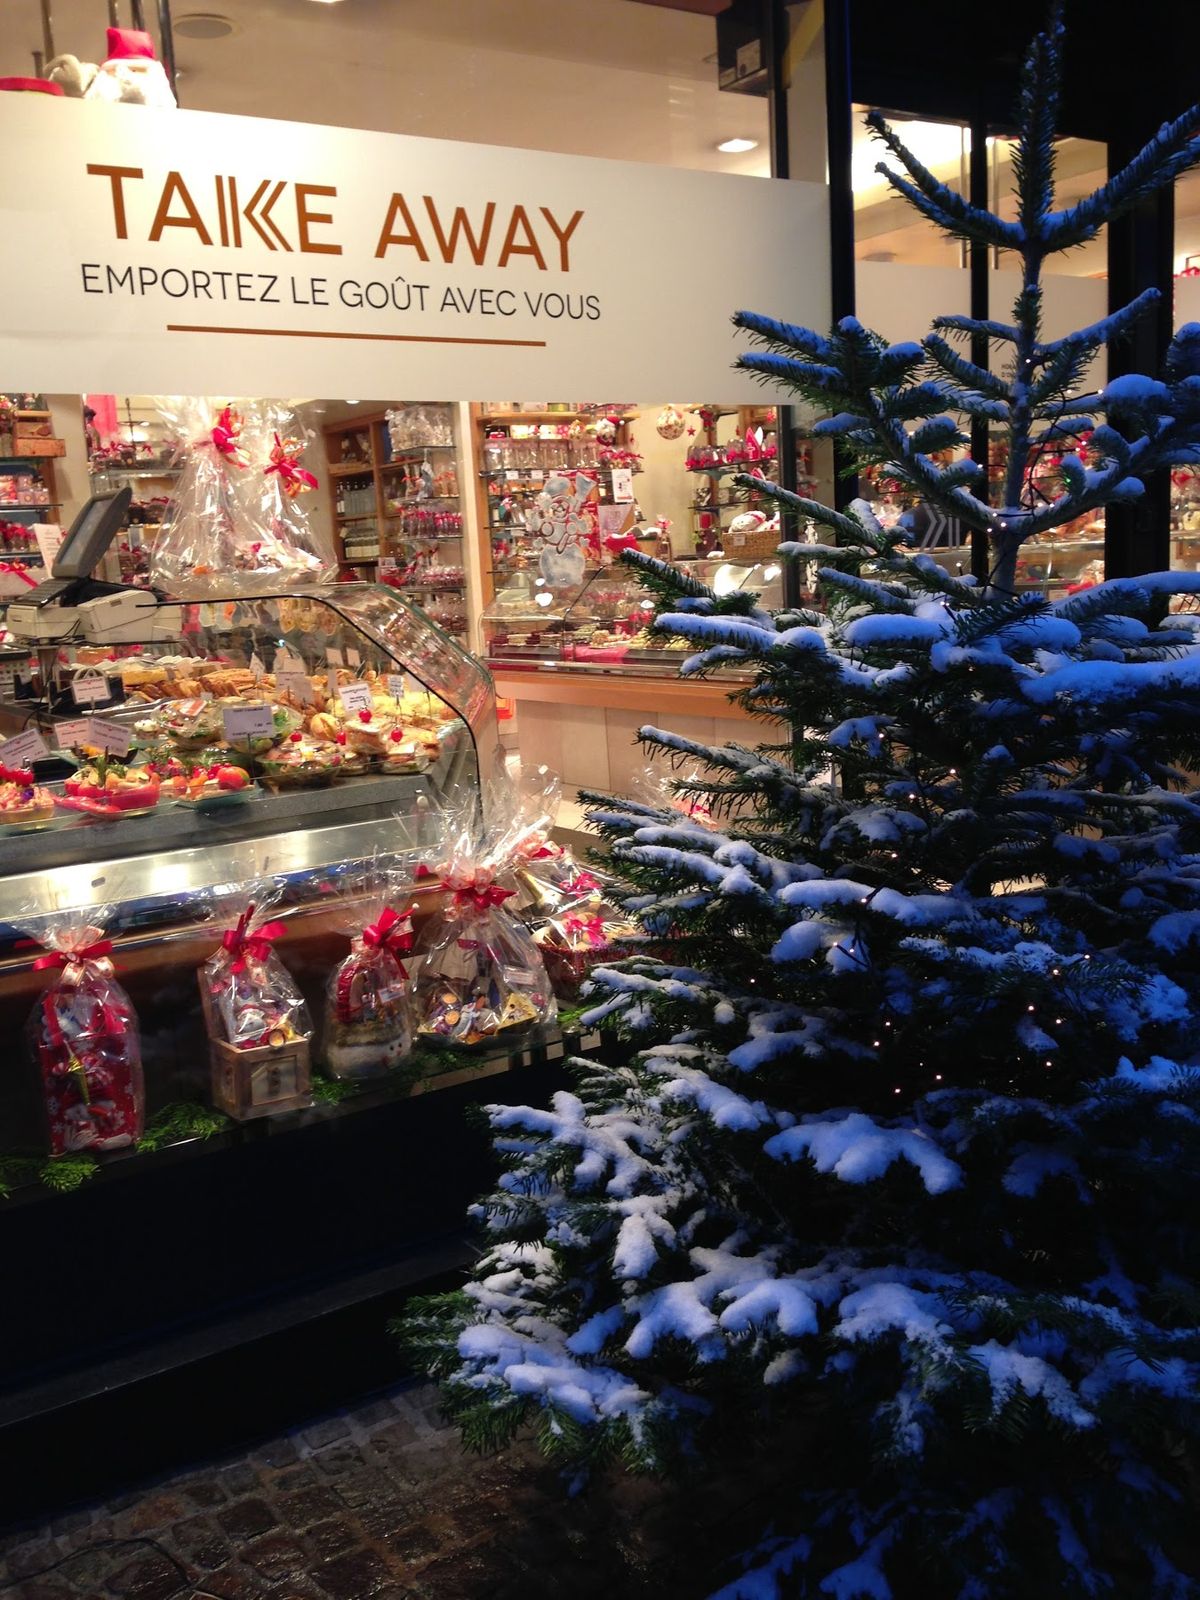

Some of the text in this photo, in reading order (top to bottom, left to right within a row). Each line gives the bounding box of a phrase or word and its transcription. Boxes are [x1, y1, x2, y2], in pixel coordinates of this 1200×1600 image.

[86, 163, 585, 273] TAKE AWAY
[81, 263, 601, 321] EMPORTEZ LE GOÛT AVEC VOUS
